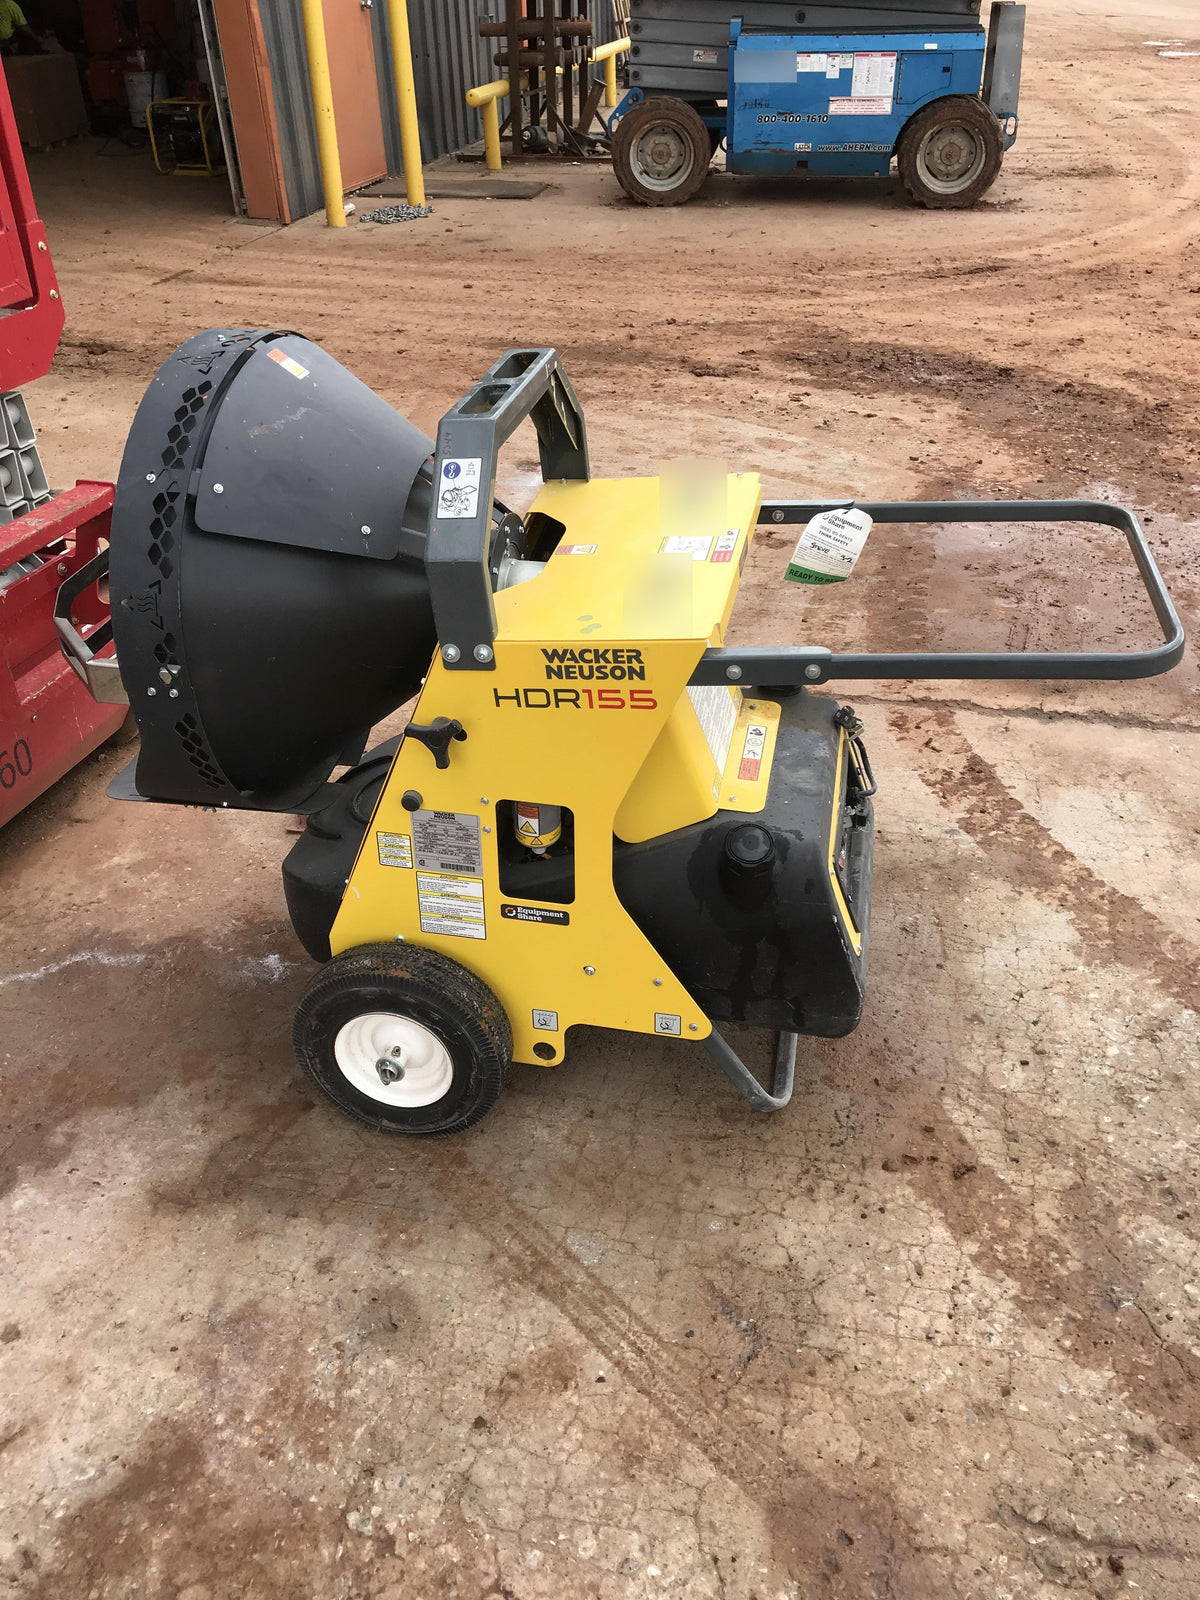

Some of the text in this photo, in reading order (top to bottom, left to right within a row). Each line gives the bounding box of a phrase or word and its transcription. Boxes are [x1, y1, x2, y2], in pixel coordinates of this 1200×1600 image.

[756, 114, 829, 124] 800-400-1610
[818, 143, 891, 151] www.AHERN.com
[827, 518, 846, 531] Share
[830, 514, 863, 532] Equipment
[788, 568, 813, 580] READY
[541, 648, 645, 664] WACKER
[545, 665, 646, 680] NEUSON
[493, 687, 658, 710] HDR155
[517, 907, 564, 918] Equipment
[517, 913, 543, 922] Share
